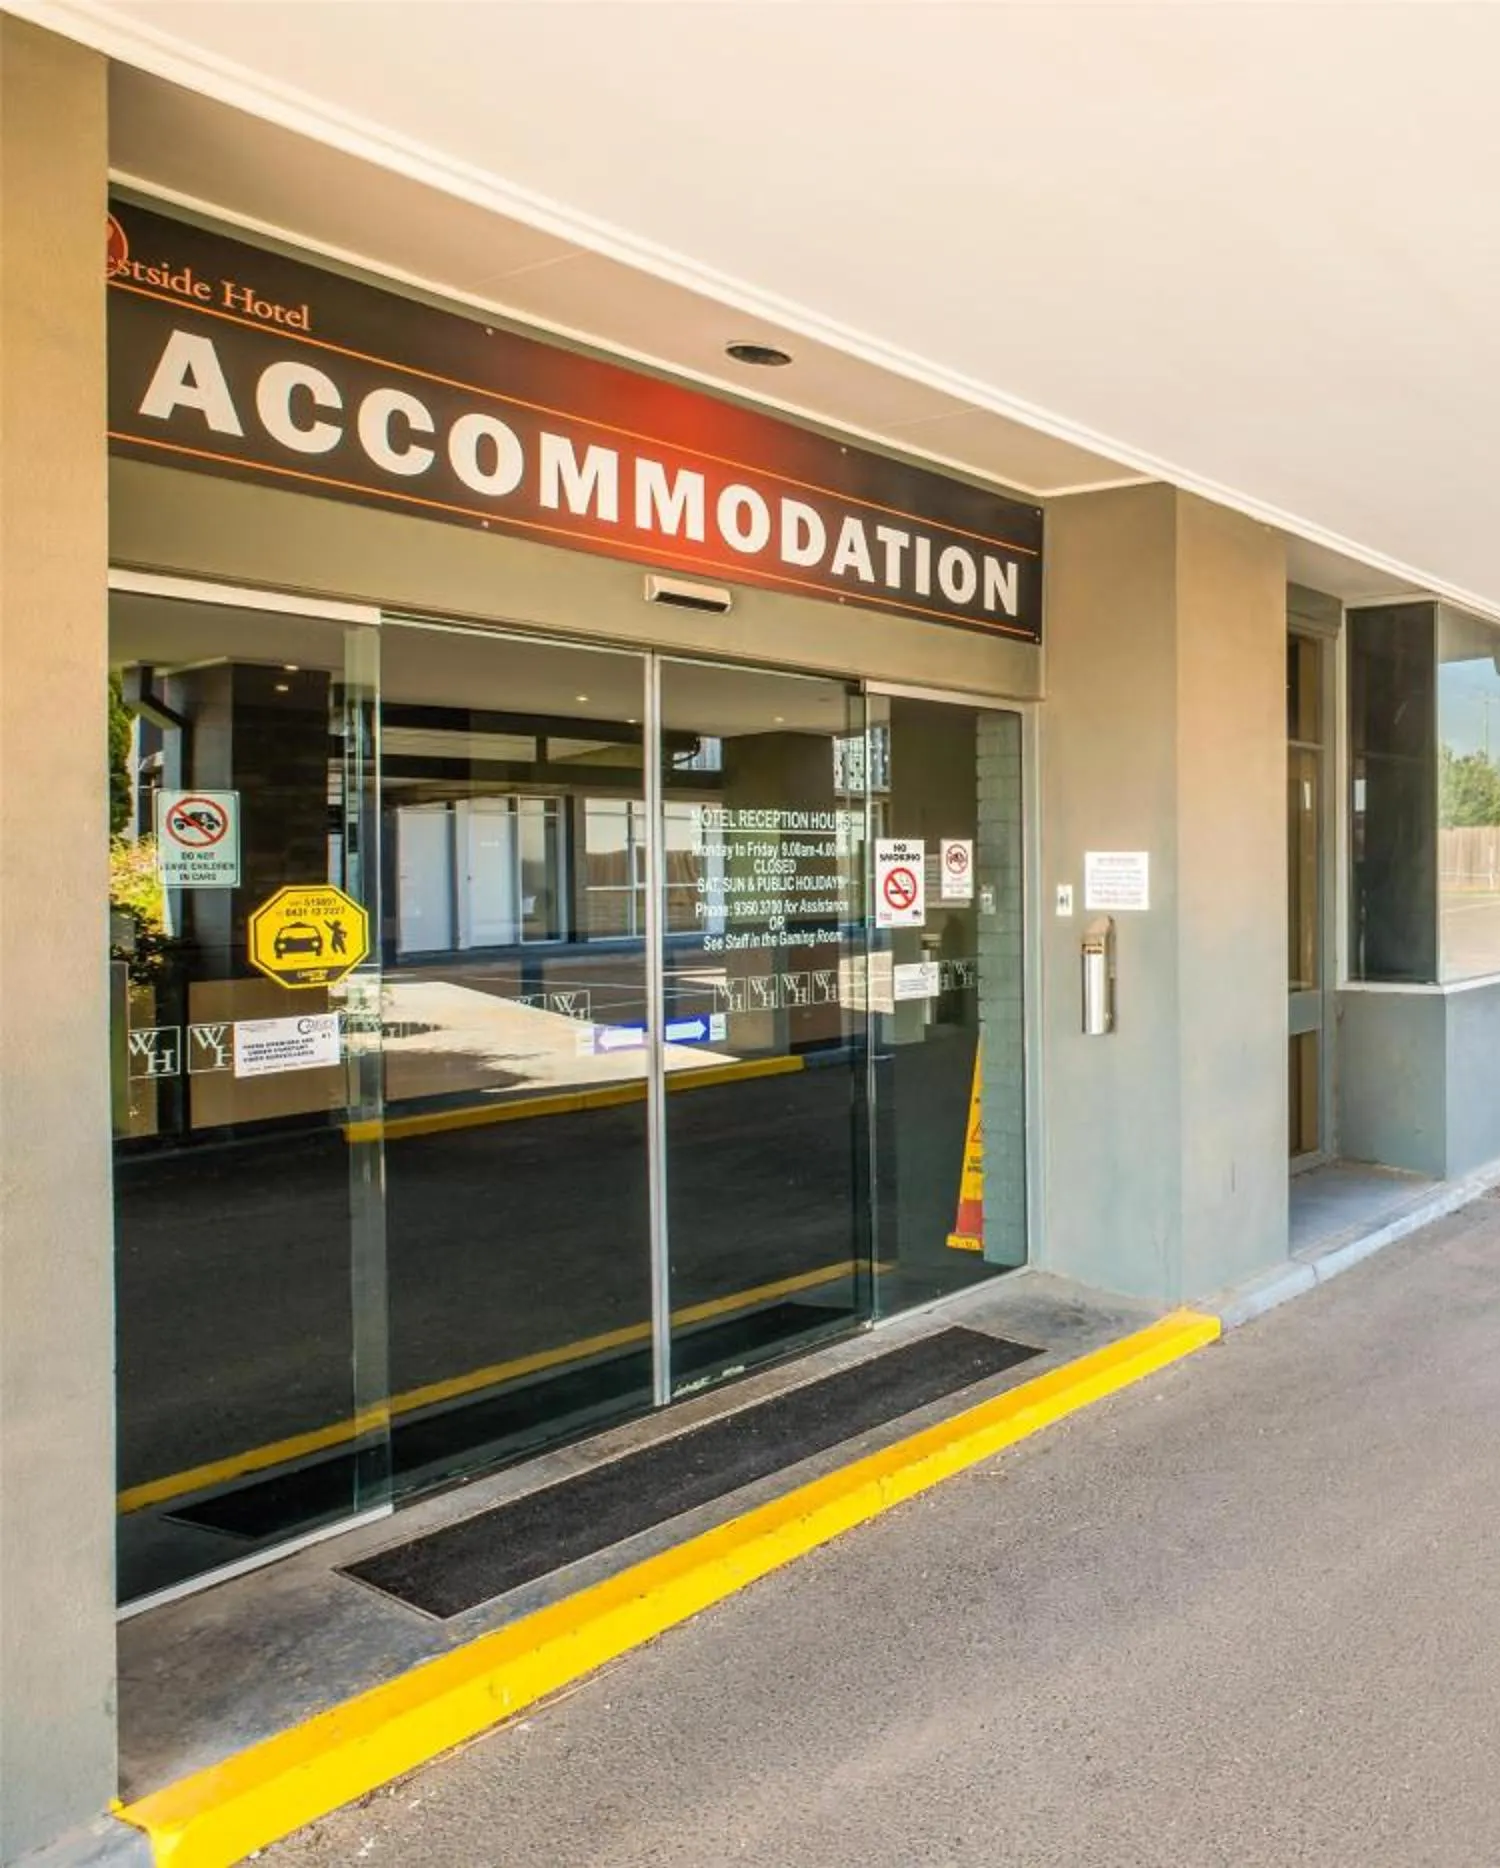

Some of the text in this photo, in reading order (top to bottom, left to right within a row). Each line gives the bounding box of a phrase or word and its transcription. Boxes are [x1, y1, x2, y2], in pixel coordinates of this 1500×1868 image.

[221, 279, 311, 331] Hotel
[138, 329, 1018, 616] ACCOMMODATION
[739, 809, 809, 829] RECEPTION
[181, 851, 216, 860] DO NOT
[747, 841, 778, 859] Friday
[893, 843, 906, 853] NO
[753, 859, 797, 875] CLOSED
[180, 873, 217, 881] IN CARS
[722, 877, 746, 892] SUN
[747, 877, 755, 891] &
[757, 876, 795, 891] PUBLIC
[784, 899, 798, 913] for
[769, 916, 785, 931] OR
[703, 935, 724, 951] See
[725, 933, 749, 949] Staff
[750, 933, 760, 948] in
[762, 932, 777, 947] the
[779, 930, 815, 948] Gaming
